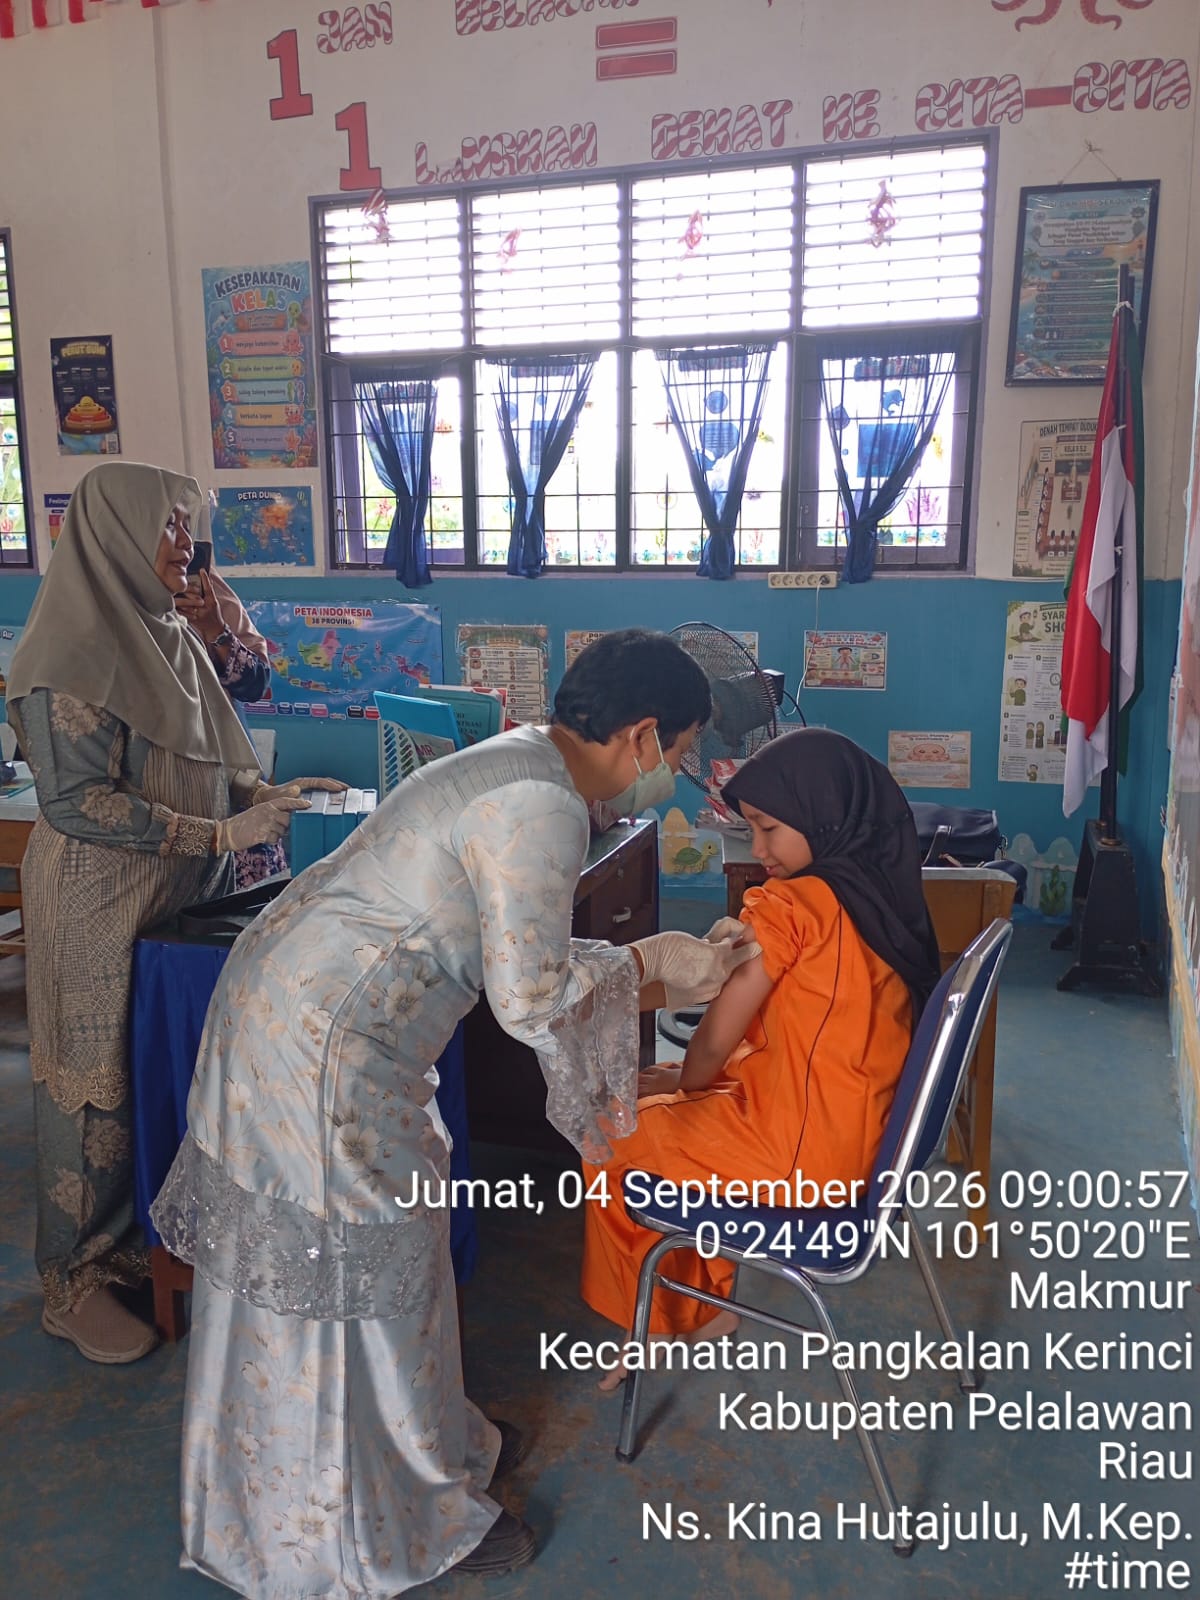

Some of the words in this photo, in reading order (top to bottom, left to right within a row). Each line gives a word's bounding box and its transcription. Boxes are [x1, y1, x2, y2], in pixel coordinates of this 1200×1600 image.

[267, 29, 313, 120] 1
[317, 1, 393, 54] JAM
[455, 0, 641, 36] BELA
[335, 101, 382, 191] 1
[651, 100, 793, 160] DEKAT
[822, 89, 880, 142] KE
[215, 271, 300, 298] KESEPAKATAN
[231, 289, 287, 314] KELAS
[238, 491, 257, 501] PETA
[295, 607, 318, 616] PETA
[320, 607, 372, 617] INDONESIA
[1041, 611, 1065, 622] SYAR
